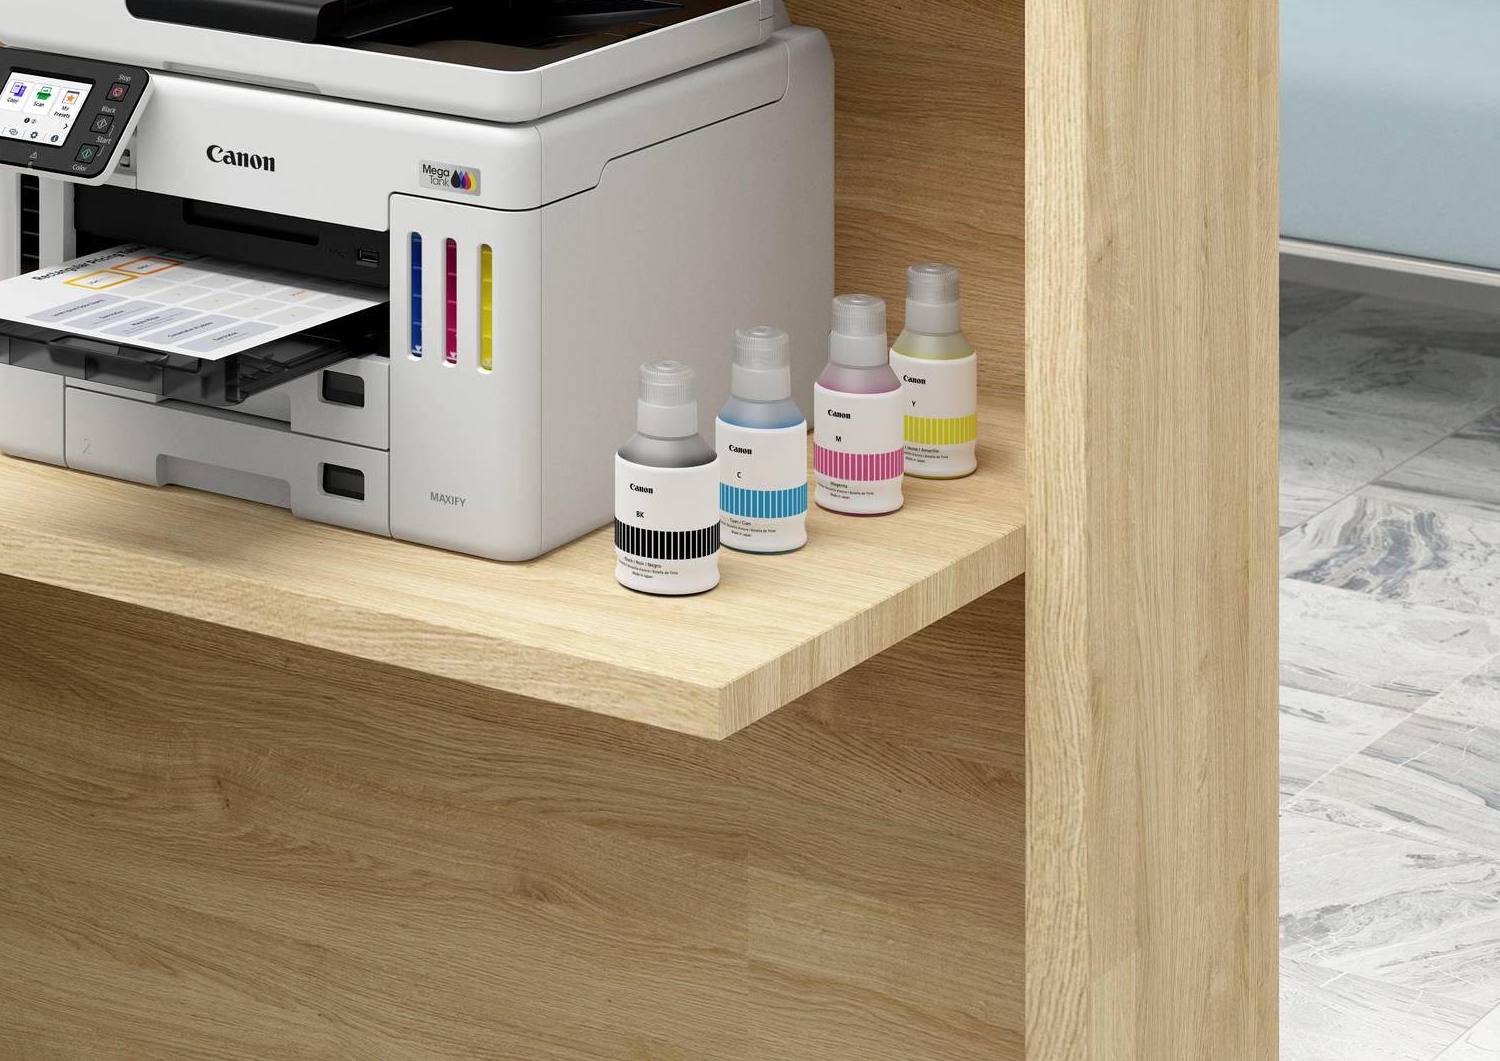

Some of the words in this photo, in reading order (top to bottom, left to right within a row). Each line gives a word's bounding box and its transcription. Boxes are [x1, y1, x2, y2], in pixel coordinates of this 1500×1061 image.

[118, 74, 131, 82] Stop
[7, 96, 20, 104] Copy
[33, 100, 45, 108] Scan
[101, 105, 117, 114] Black
[53, 111, 71, 119] Presets
[95, 136, 112, 145] Start
[206, 144, 276, 172] Canon
[72, 163, 88, 172] Color
[422, 164, 450, 178] Mega
[429, 175, 450, 188] Tank
[903, 374, 926, 385] Canon
[827, 409, 851, 420] Canon
[728, 444, 752, 455] Canon
[736, 471, 741, 479] C
[629, 483, 654, 494] Canon
[430, 491, 466, 508] MAXIFY
[636, 510, 645, 518] BK
